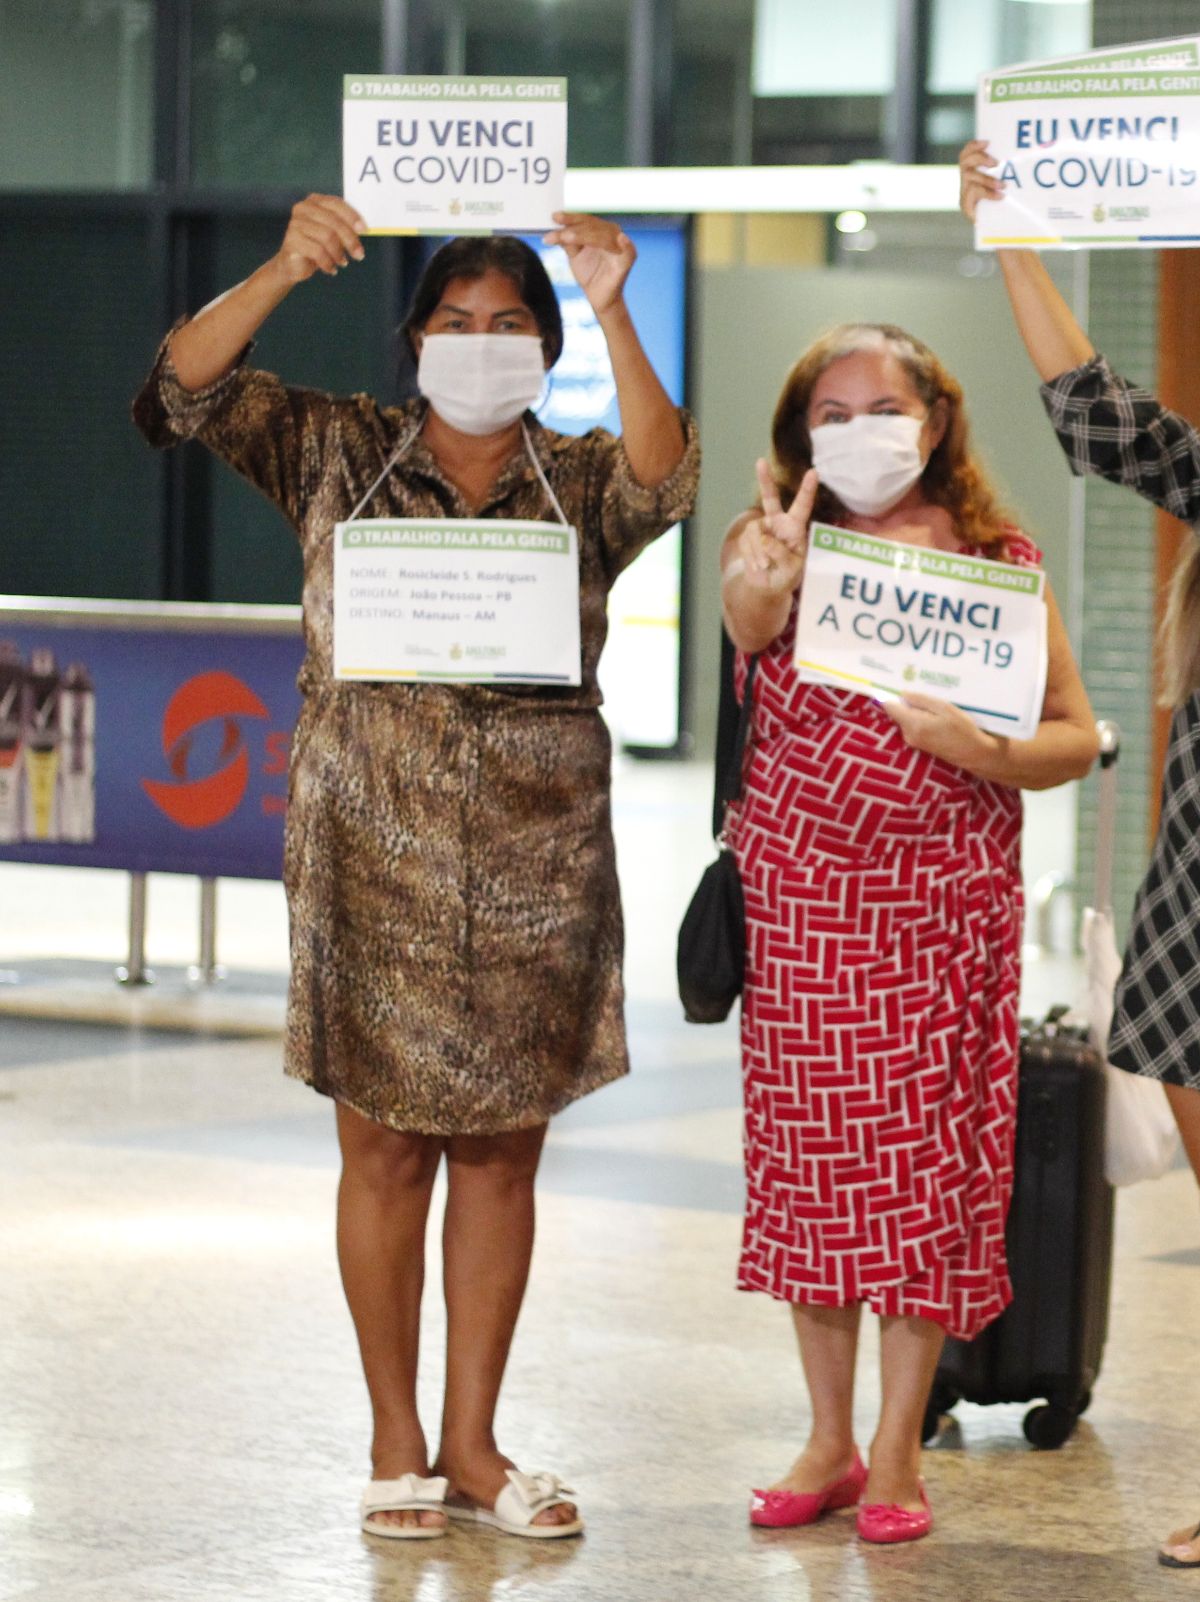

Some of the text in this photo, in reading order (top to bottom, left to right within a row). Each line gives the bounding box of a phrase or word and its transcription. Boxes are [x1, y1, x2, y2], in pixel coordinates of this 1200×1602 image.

[350, 82, 561, 98] O TRABALHO FALA PELA GENTE
[995, 81, 1007, 96] O
[1010, 78, 1081, 95] TRABALHO
[1085, 77, 1120, 92] FALA
[1123, 76, 1158, 91] PELA
[377, 119, 534, 148] EU VENCI
[1016, 116, 1179, 149] EU VENCI
[359, 155, 551, 185] A COVID-19
[1001, 157, 1198, 189] A COVID-19
[349, 529, 564, 550] O TRABALHO FALA PELA GENTE
[399, 568, 460, 581] Rosicleide
[477, 571, 537, 584] Rodrigues
[820, 533, 833, 545] O
[950, 558, 984, 580] PELA
[988, 568, 1034, 590] GENTE
[409, 587, 437, 601] João
[441, 589, 482, 601] Pessoa
[496, 590, 512, 602] PB
[841, 573, 1001, 631] EU VENCI
[412, 608, 461, 621] Manaus
[475, 609, 496, 622] AM
[817, 604, 841, 631] A
[852, 612, 1014, 669] COVID-19
